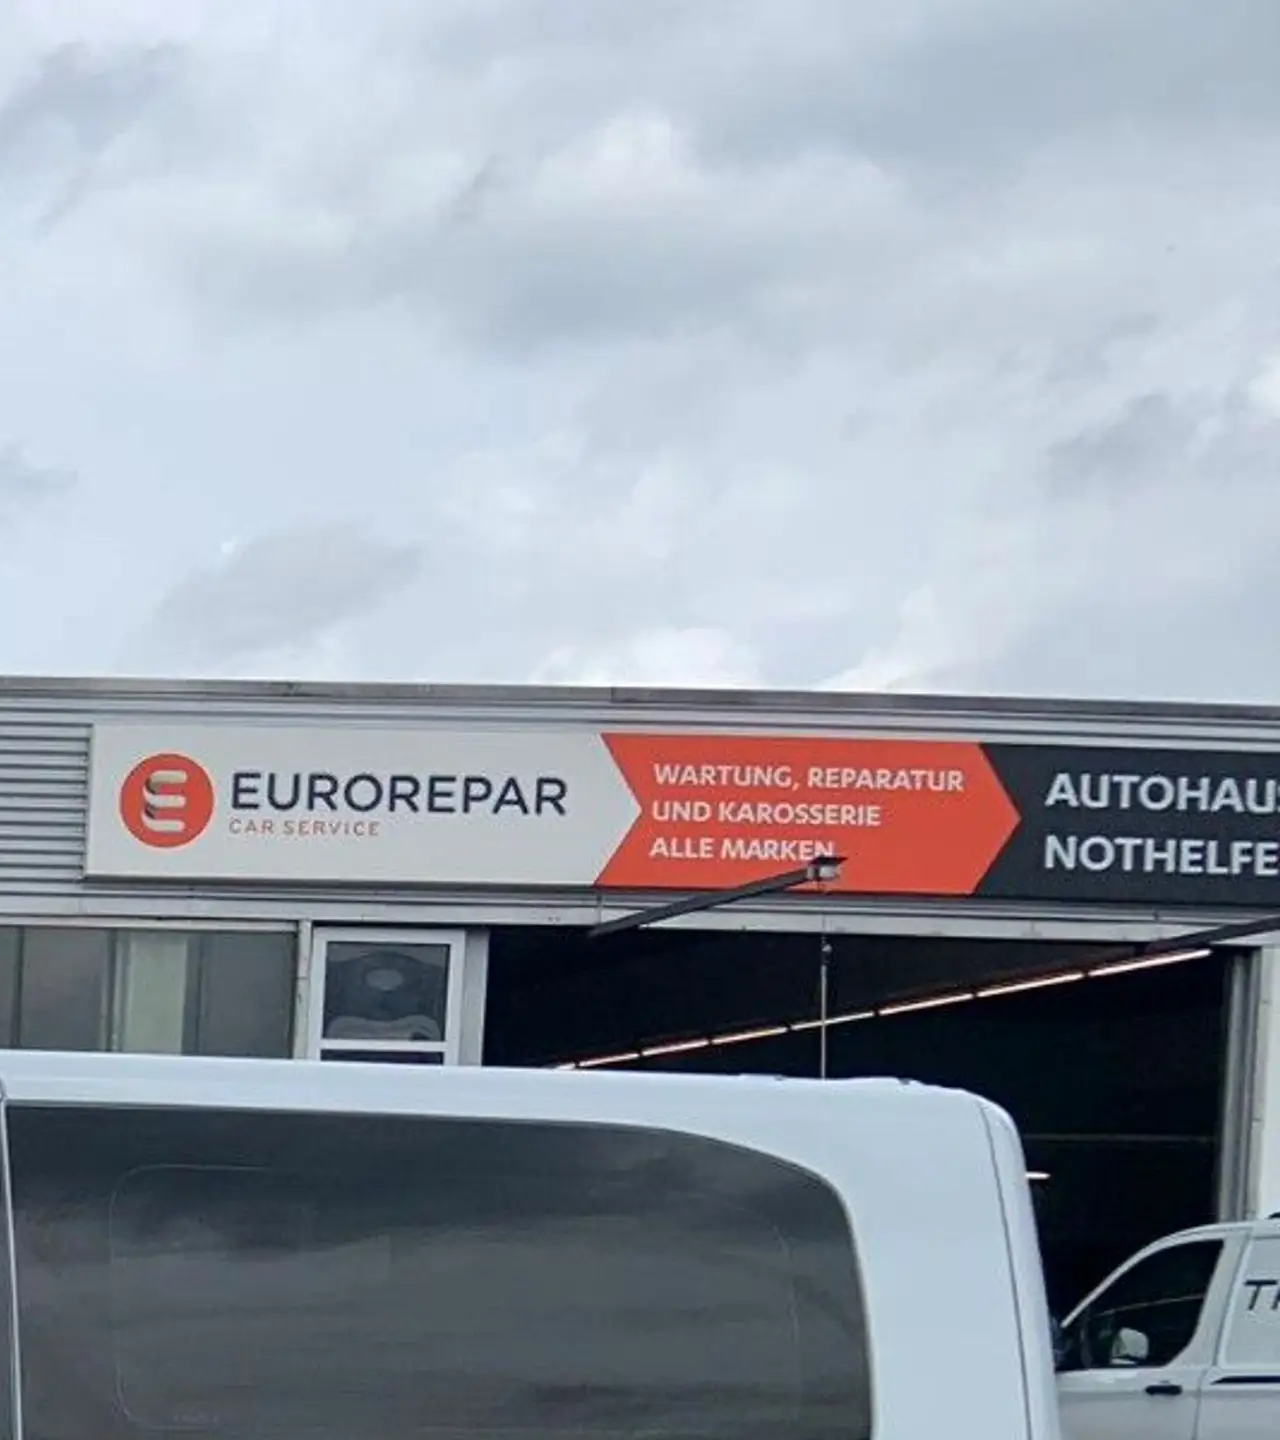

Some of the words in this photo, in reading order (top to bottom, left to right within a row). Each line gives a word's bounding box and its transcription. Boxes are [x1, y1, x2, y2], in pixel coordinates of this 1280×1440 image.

[653, 762, 801, 791] WARTUNG,
[807, 767, 965, 792] REPARATUR
[231, 771, 568, 816] EUROREPAR
[1044, 772, 1280, 814] AUTOHAU
[651, 799, 712, 822] UND
[718, 801, 882, 827] KAROSSERIE
[228, 818, 275, 836] CAR
[282, 818, 381, 838] SERVICE
[648, 836, 715, 860] ALLE
[720, 837, 835, 861] MARKEN
